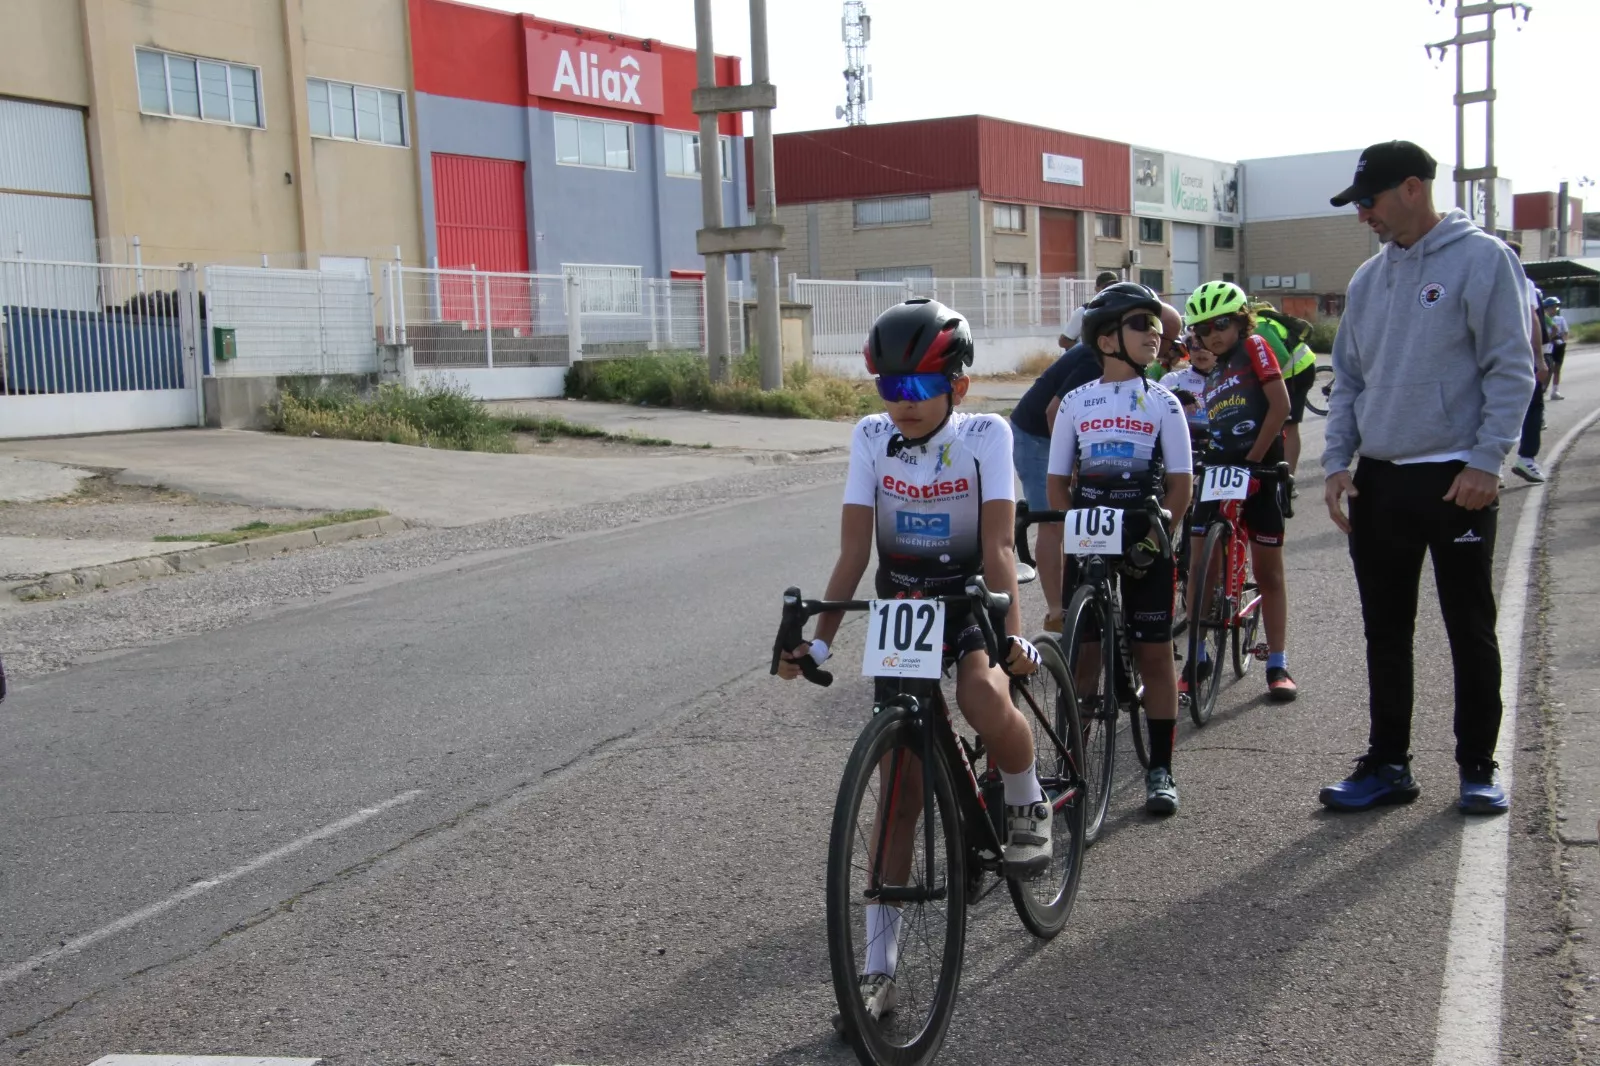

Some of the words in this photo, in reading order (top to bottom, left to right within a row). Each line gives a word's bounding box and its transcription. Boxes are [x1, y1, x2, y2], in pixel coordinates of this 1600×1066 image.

[1080, 415, 1154, 433] ecotisa
[882, 475, 969, 499] ecotisa
[1210, 466, 1243, 488] 105
[1075, 507, 1115, 536] 103
[896, 536, 951, 548] INGENIEROS
[878, 603, 936, 652] 102
